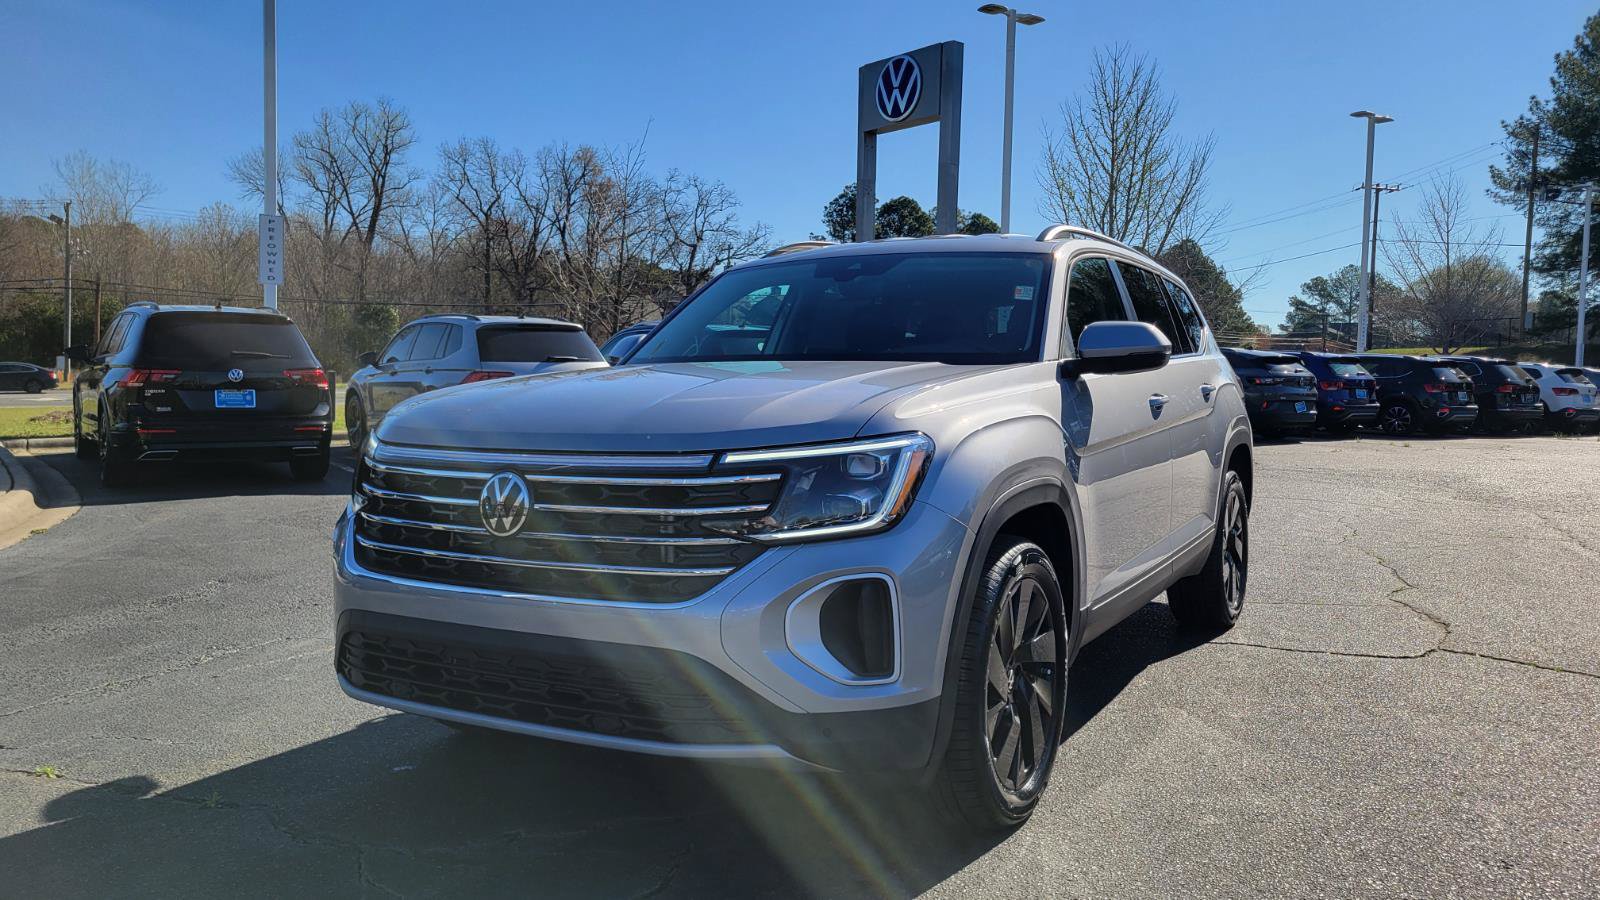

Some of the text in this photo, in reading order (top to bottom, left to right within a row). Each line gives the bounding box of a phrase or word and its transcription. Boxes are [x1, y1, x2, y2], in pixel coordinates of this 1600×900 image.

[877, 56, 919, 118] VW
[267, 219, 277, 281] PREOWNED
[482, 473, 527, 533] VW
